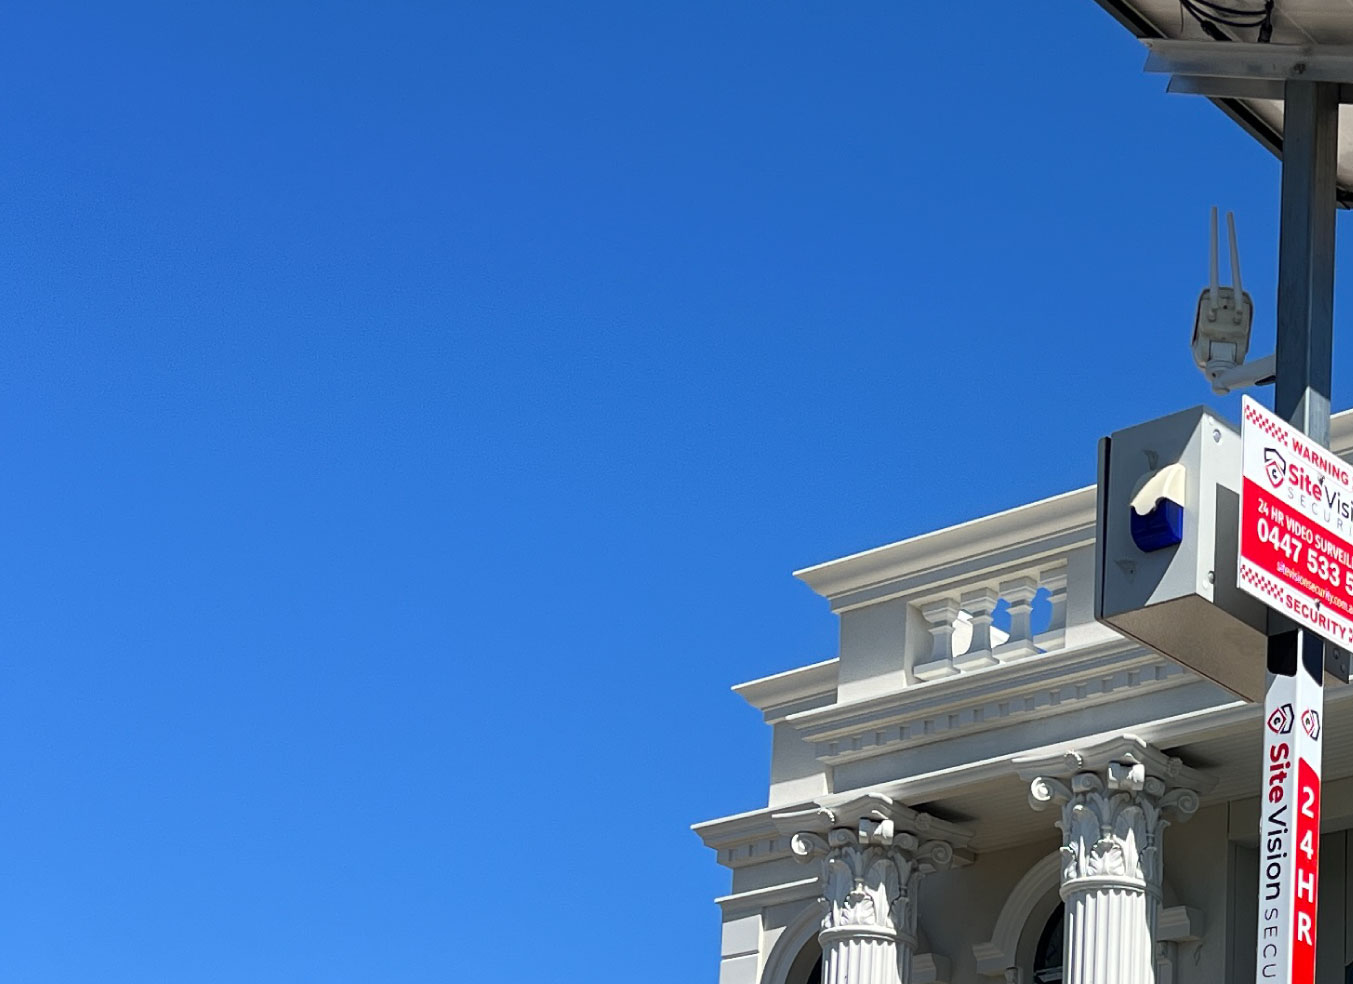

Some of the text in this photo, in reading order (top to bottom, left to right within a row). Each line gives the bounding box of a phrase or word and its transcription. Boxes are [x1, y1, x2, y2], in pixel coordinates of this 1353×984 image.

[1292, 437, 1349, 486] WARNING
[1258, 497, 1269, 517] 24
[1270, 505, 1285, 527] HR
[1285, 515, 1314, 545] VIDEO
[1257, 517, 1303, 564] 0447
[1306, 547, 1341, 588] 533
[1285, 593, 1347, 641] SECURITY
[1261, 907, 1279, 979] SECU
